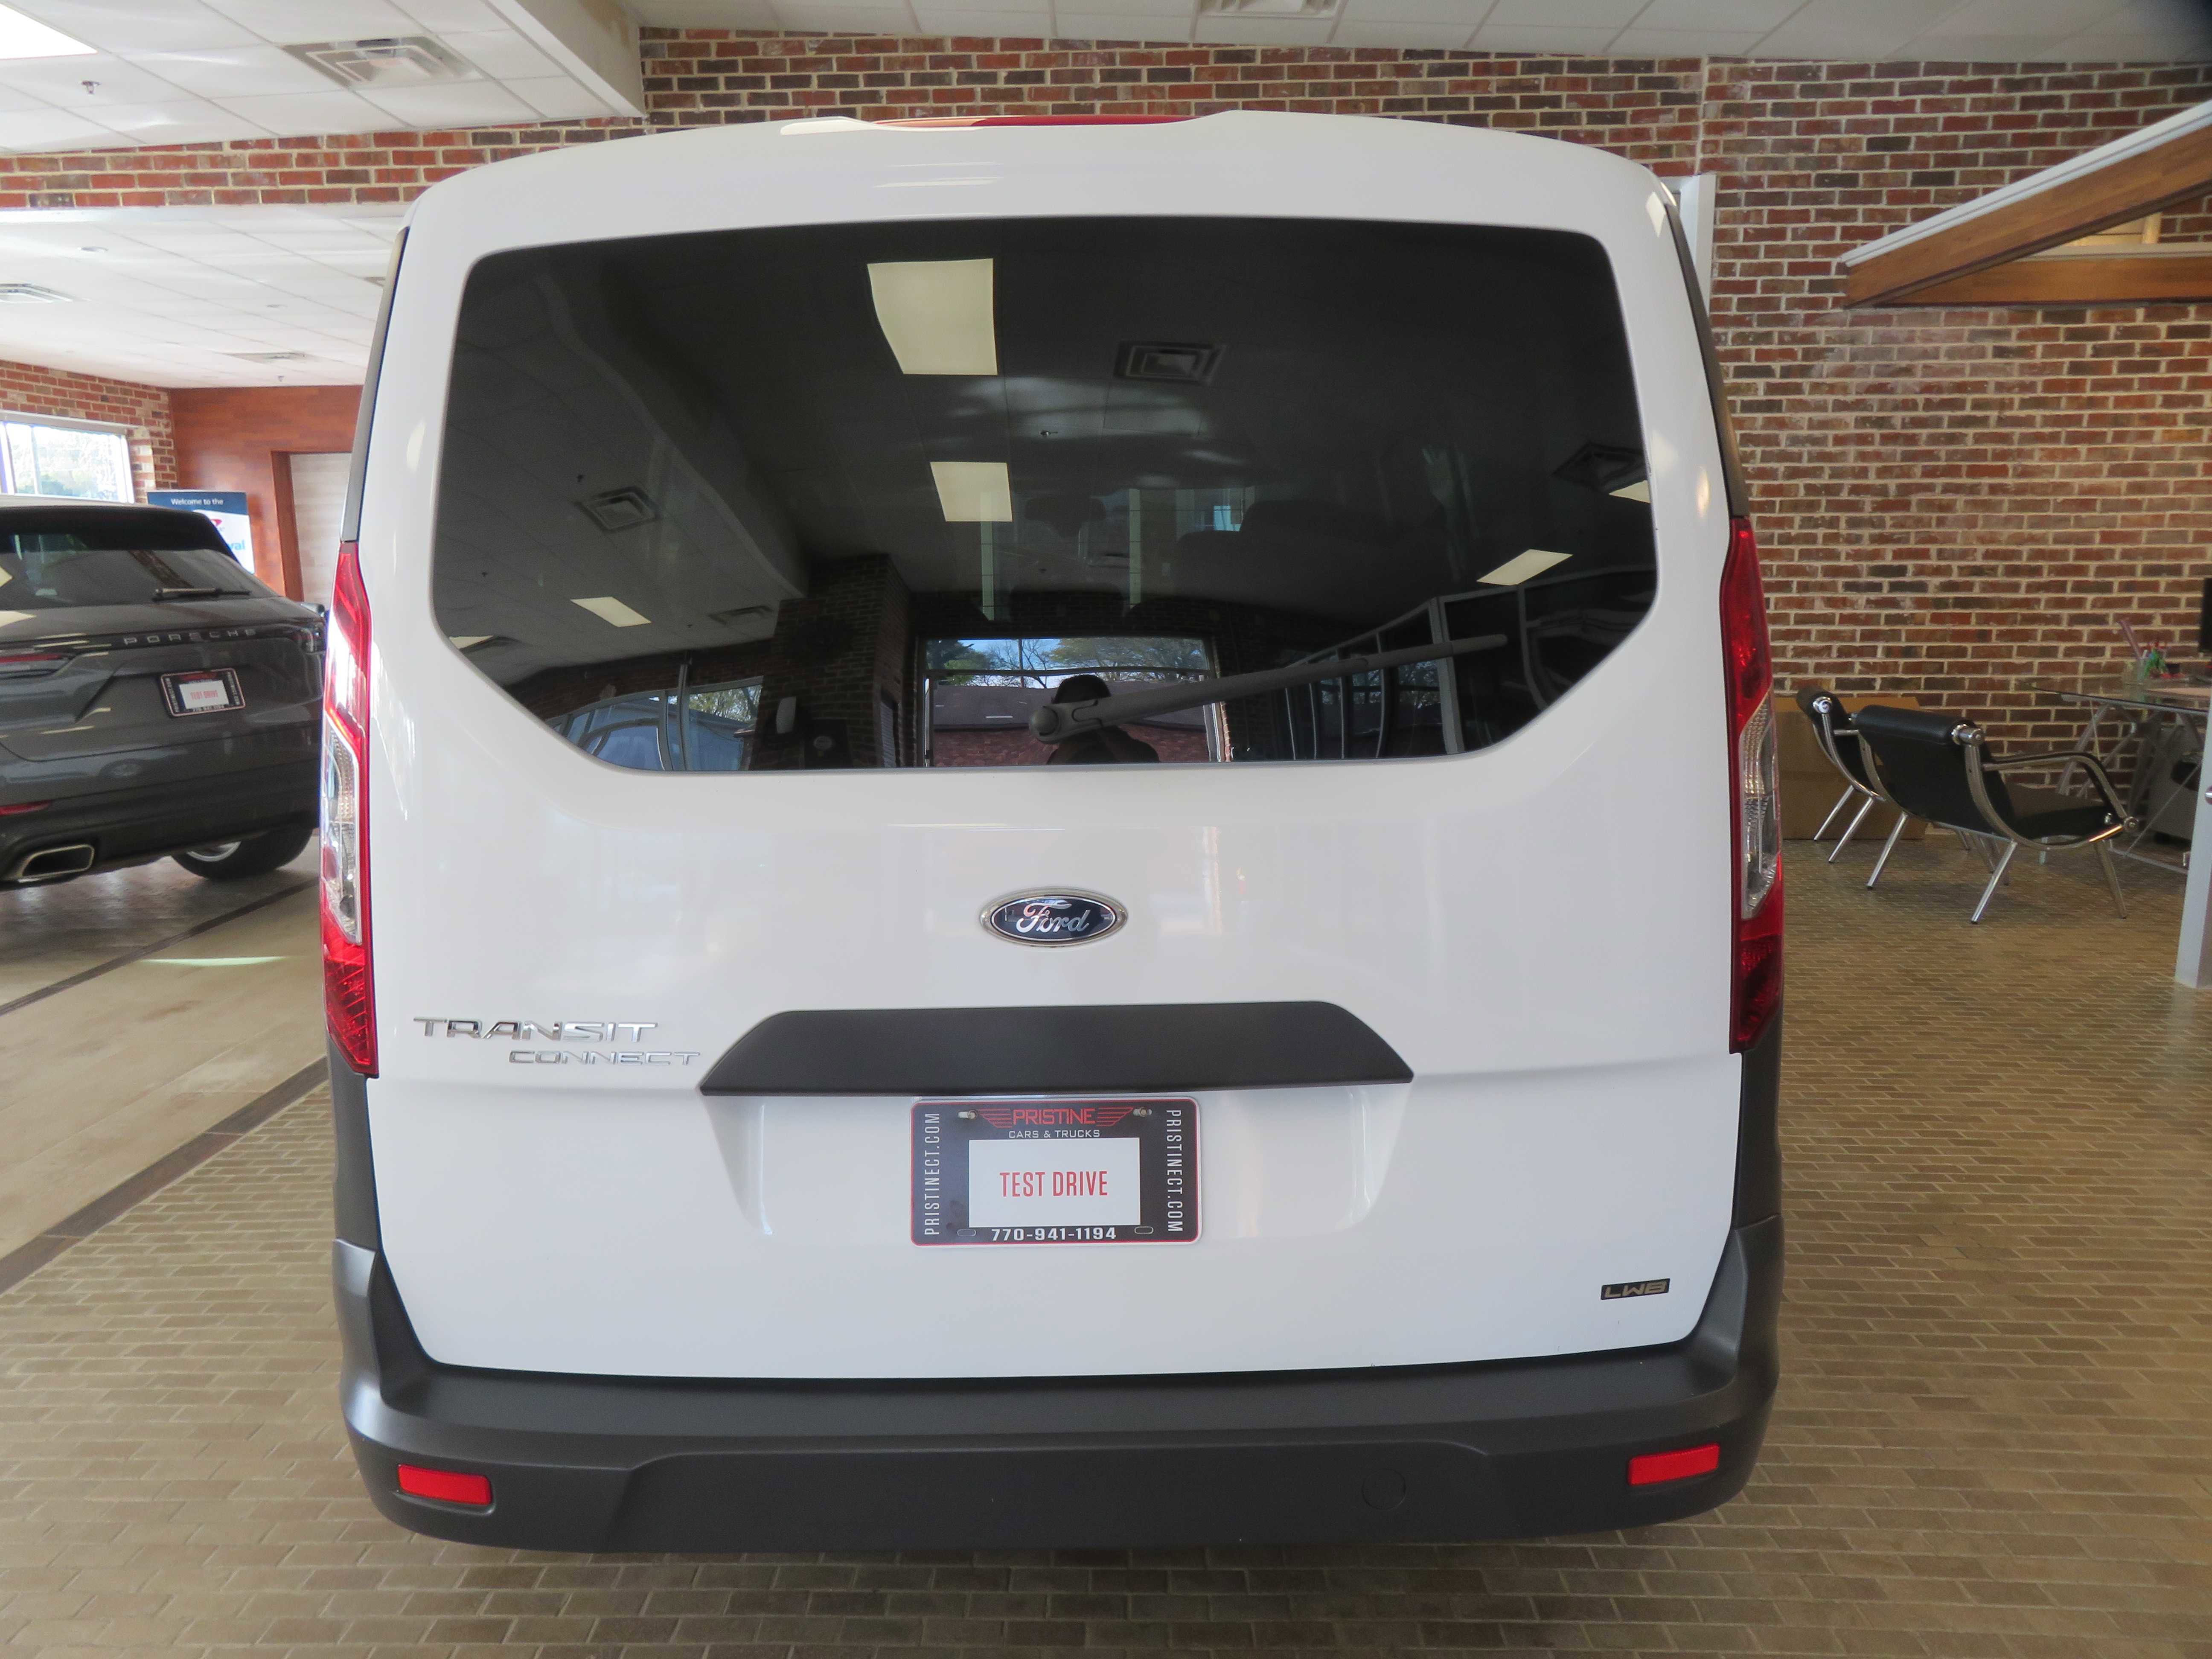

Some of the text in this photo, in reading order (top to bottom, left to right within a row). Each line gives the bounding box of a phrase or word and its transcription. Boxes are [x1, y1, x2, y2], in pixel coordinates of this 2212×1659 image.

[124, 628, 256, 645] PORSCHE
[1016, 902, 1091, 933] Ford
[413, 1017, 658, 1042] TRANSIT
[509, 1051, 700, 1065] CONNECT
[1013, 1108, 1095, 1125] PRISTINE
[1009, 1129, 1100, 1139] CARS & TRUCKS
[924, 1113, 940, 1235] PRISTINECT.COM
[1166, 1109, 1183, 1232] PRISTINECT.COM
[1000, 1171, 1108, 1197] TEST DRIVE
[991, 1227, 1116, 1241] 770-941-1194
[1605, 1281, 1667, 1298] LWB
